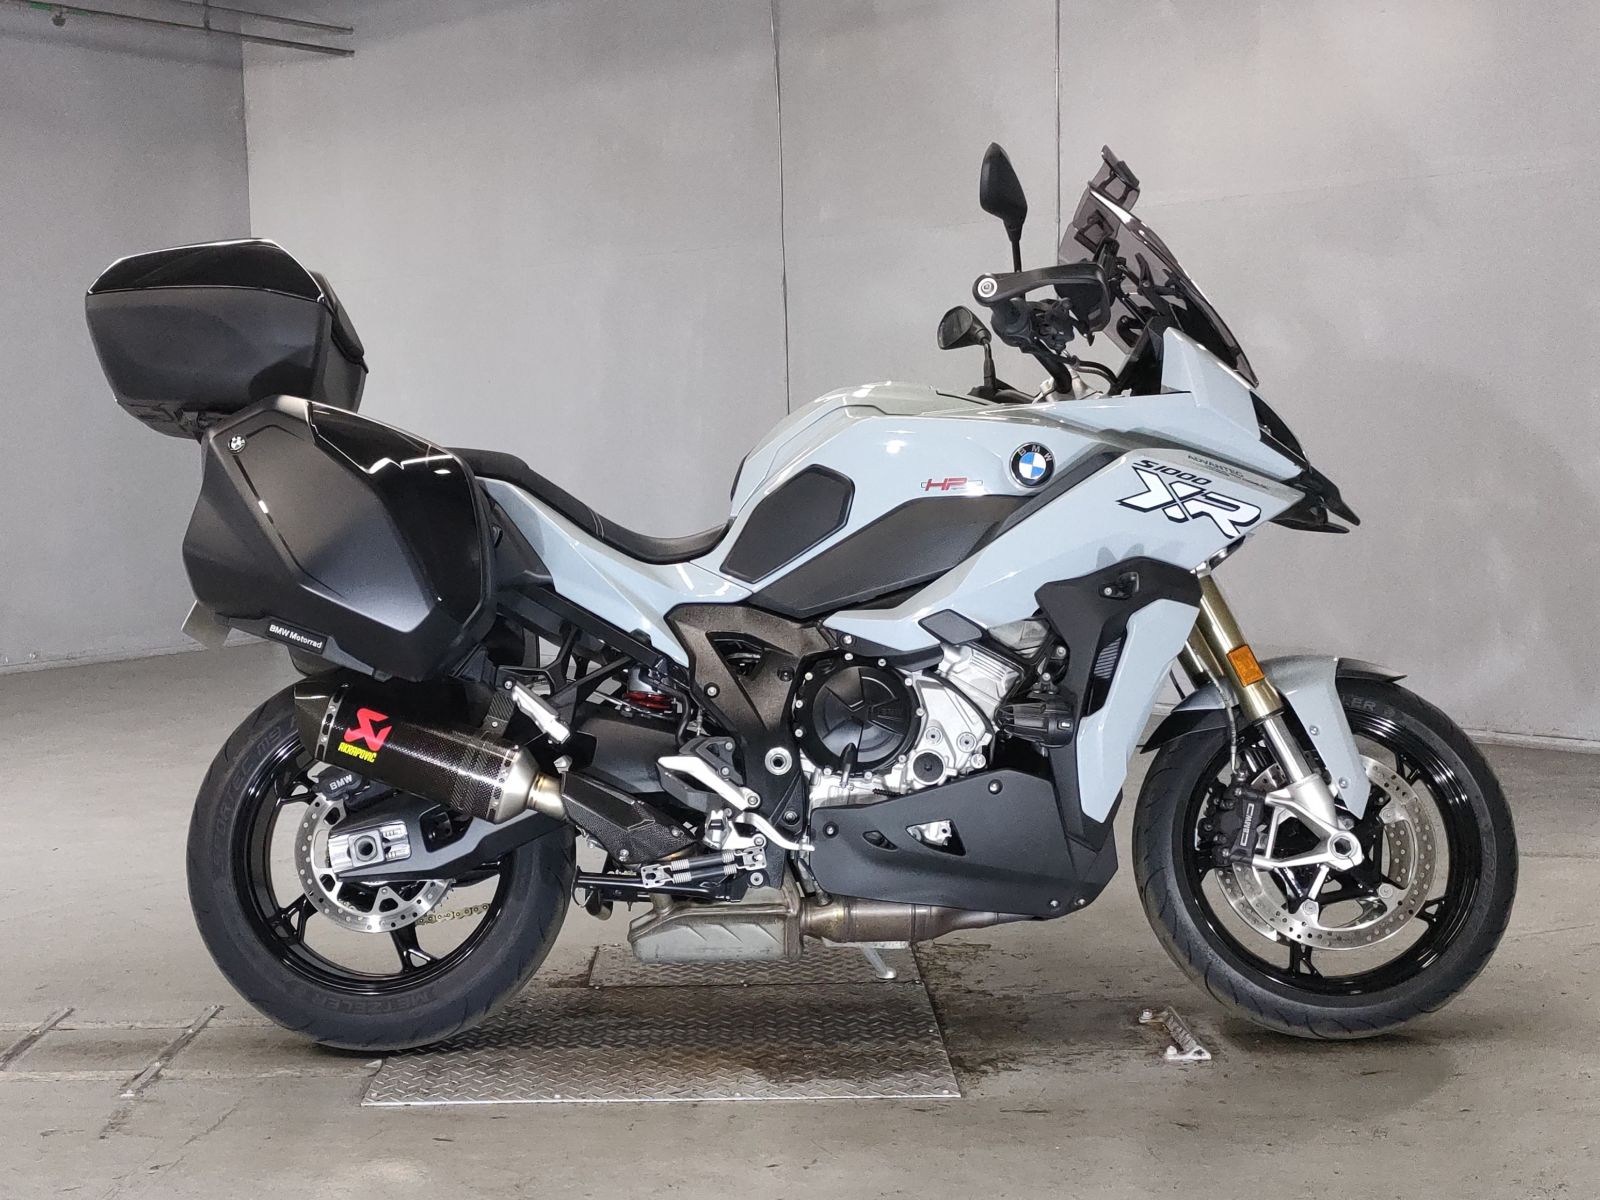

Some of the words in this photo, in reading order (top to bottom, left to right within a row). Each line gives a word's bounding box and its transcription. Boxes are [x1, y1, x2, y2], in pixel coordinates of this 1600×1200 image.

[925, 477, 967, 491] HP
[1133, 459, 1212, 486] S1000
[1116, 466, 1262, 539] XR
[269, 624, 291, 638] BMW
[289, 631, 323, 649] Motorrad
[329, 774, 353, 790] BMW
